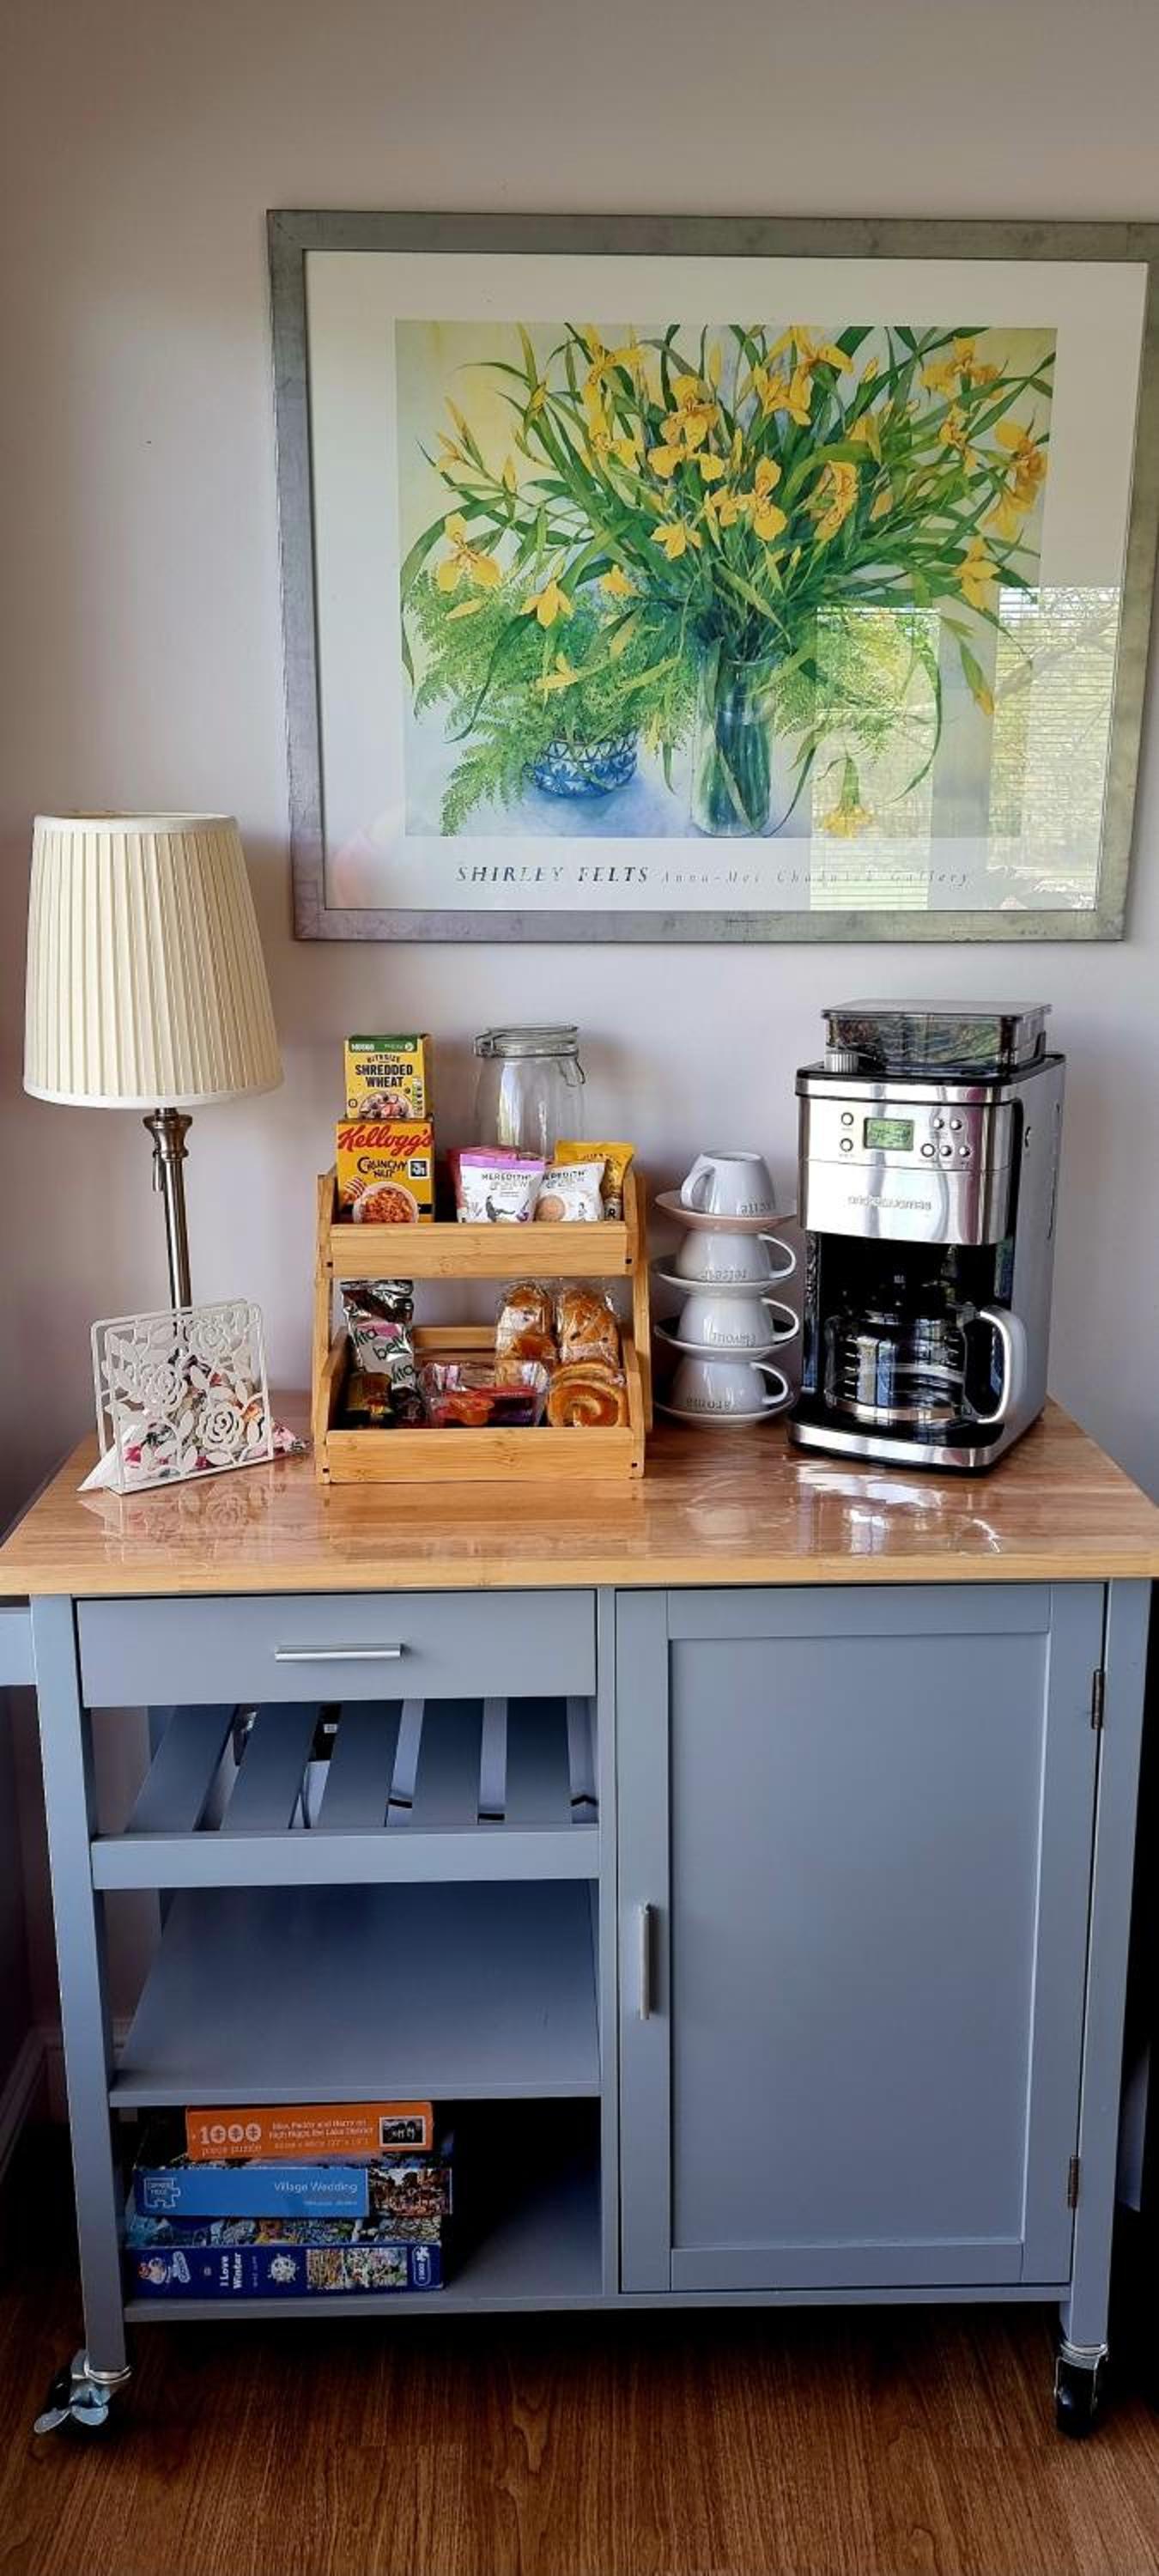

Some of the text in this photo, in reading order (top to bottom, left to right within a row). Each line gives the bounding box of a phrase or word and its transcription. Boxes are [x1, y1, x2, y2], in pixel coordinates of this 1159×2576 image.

[455, 866, 564, 882] SHIRLEY
[578, 866, 649, 882] FELTS
[355, 1064, 414, 1076] SHREDDED
[366, 1076, 404, 1088] WHEAT
[337, 1125, 433, 1157] Kellogg's
[357, 1156, 408, 1175] CRUNCHY
[373, 1170, 396, 1179] NUT
[482, 1172, 530, 1181] MEREDITH
[201, 2123, 262, 2144] 1000
[231, 2143, 262, 2154] puzzle
[274, 2181, 358, 2193] Village Wedding
[219, 2255, 229, 2280] Love
[233, 2252, 243, 2290] Winter
